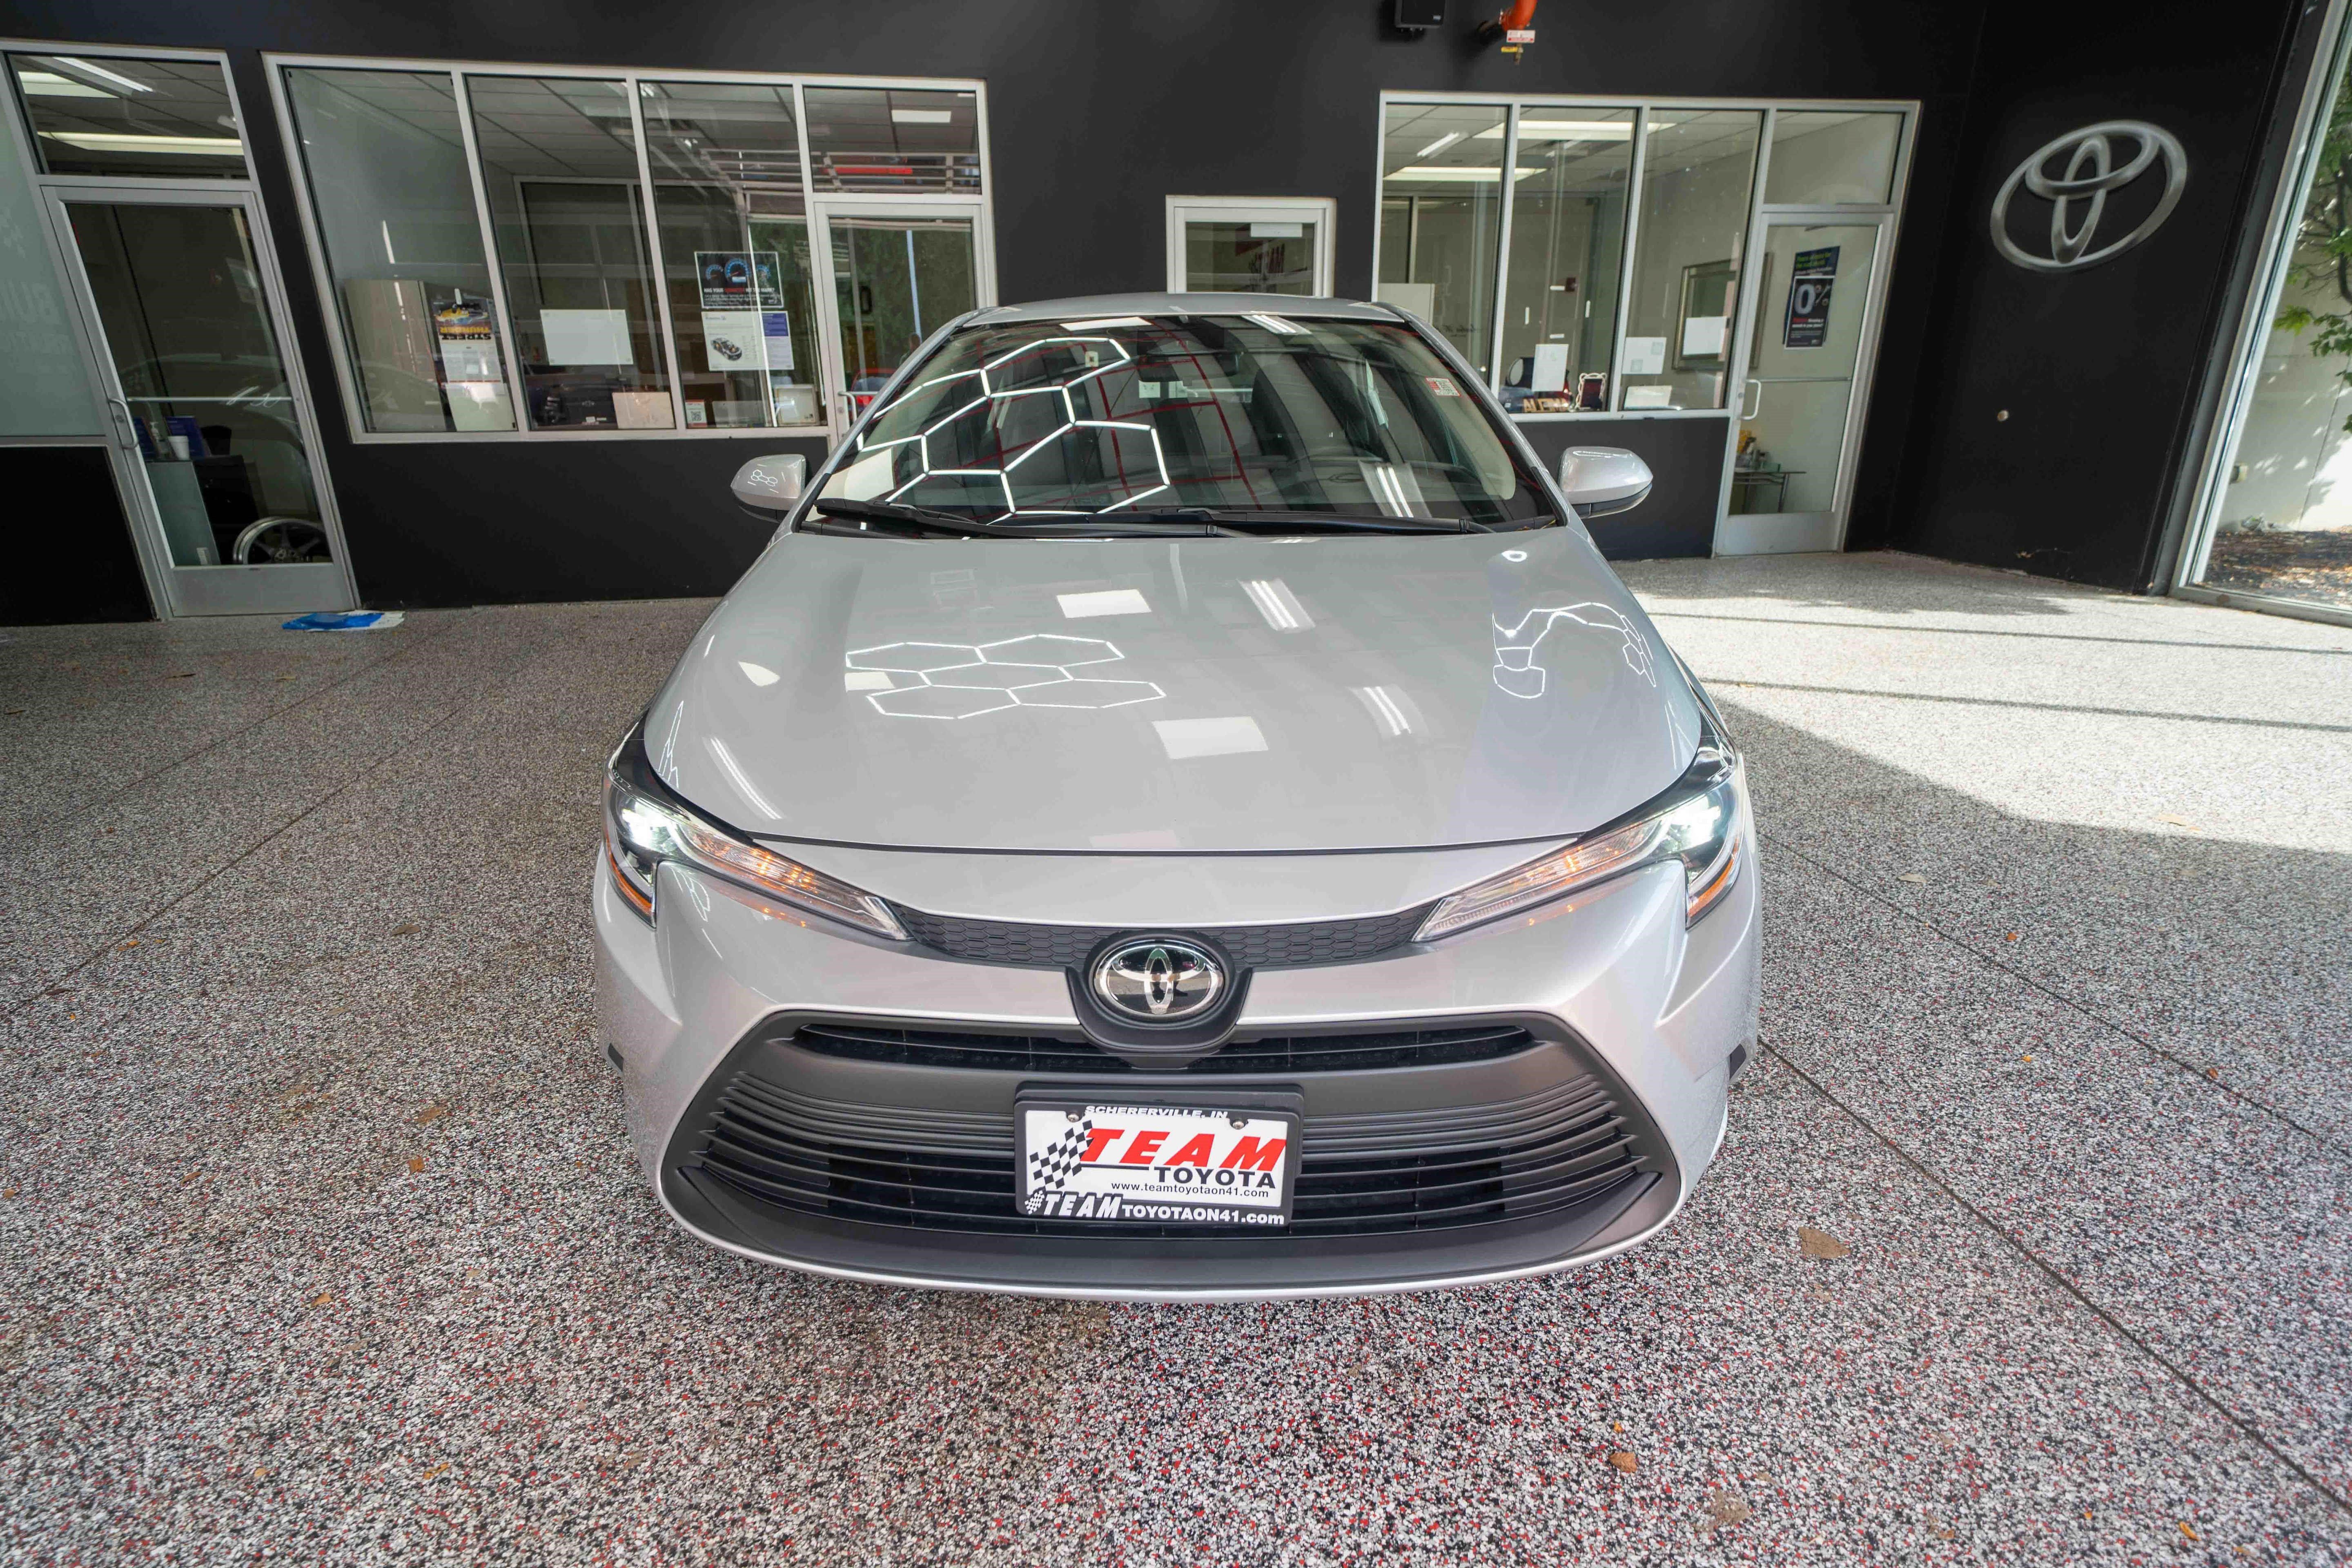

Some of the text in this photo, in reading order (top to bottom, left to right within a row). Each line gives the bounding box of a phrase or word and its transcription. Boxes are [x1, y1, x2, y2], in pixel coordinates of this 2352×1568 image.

[1085, 1105, 1228, 1118] SCHERERVILLE, IN
[1080, 1128, 1287, 1172] TEAM
[1154, 1167, 1276, 1189] TOYOTA
[1111, 1182, 1269, 1197] www.teamtoyotaon41.com
